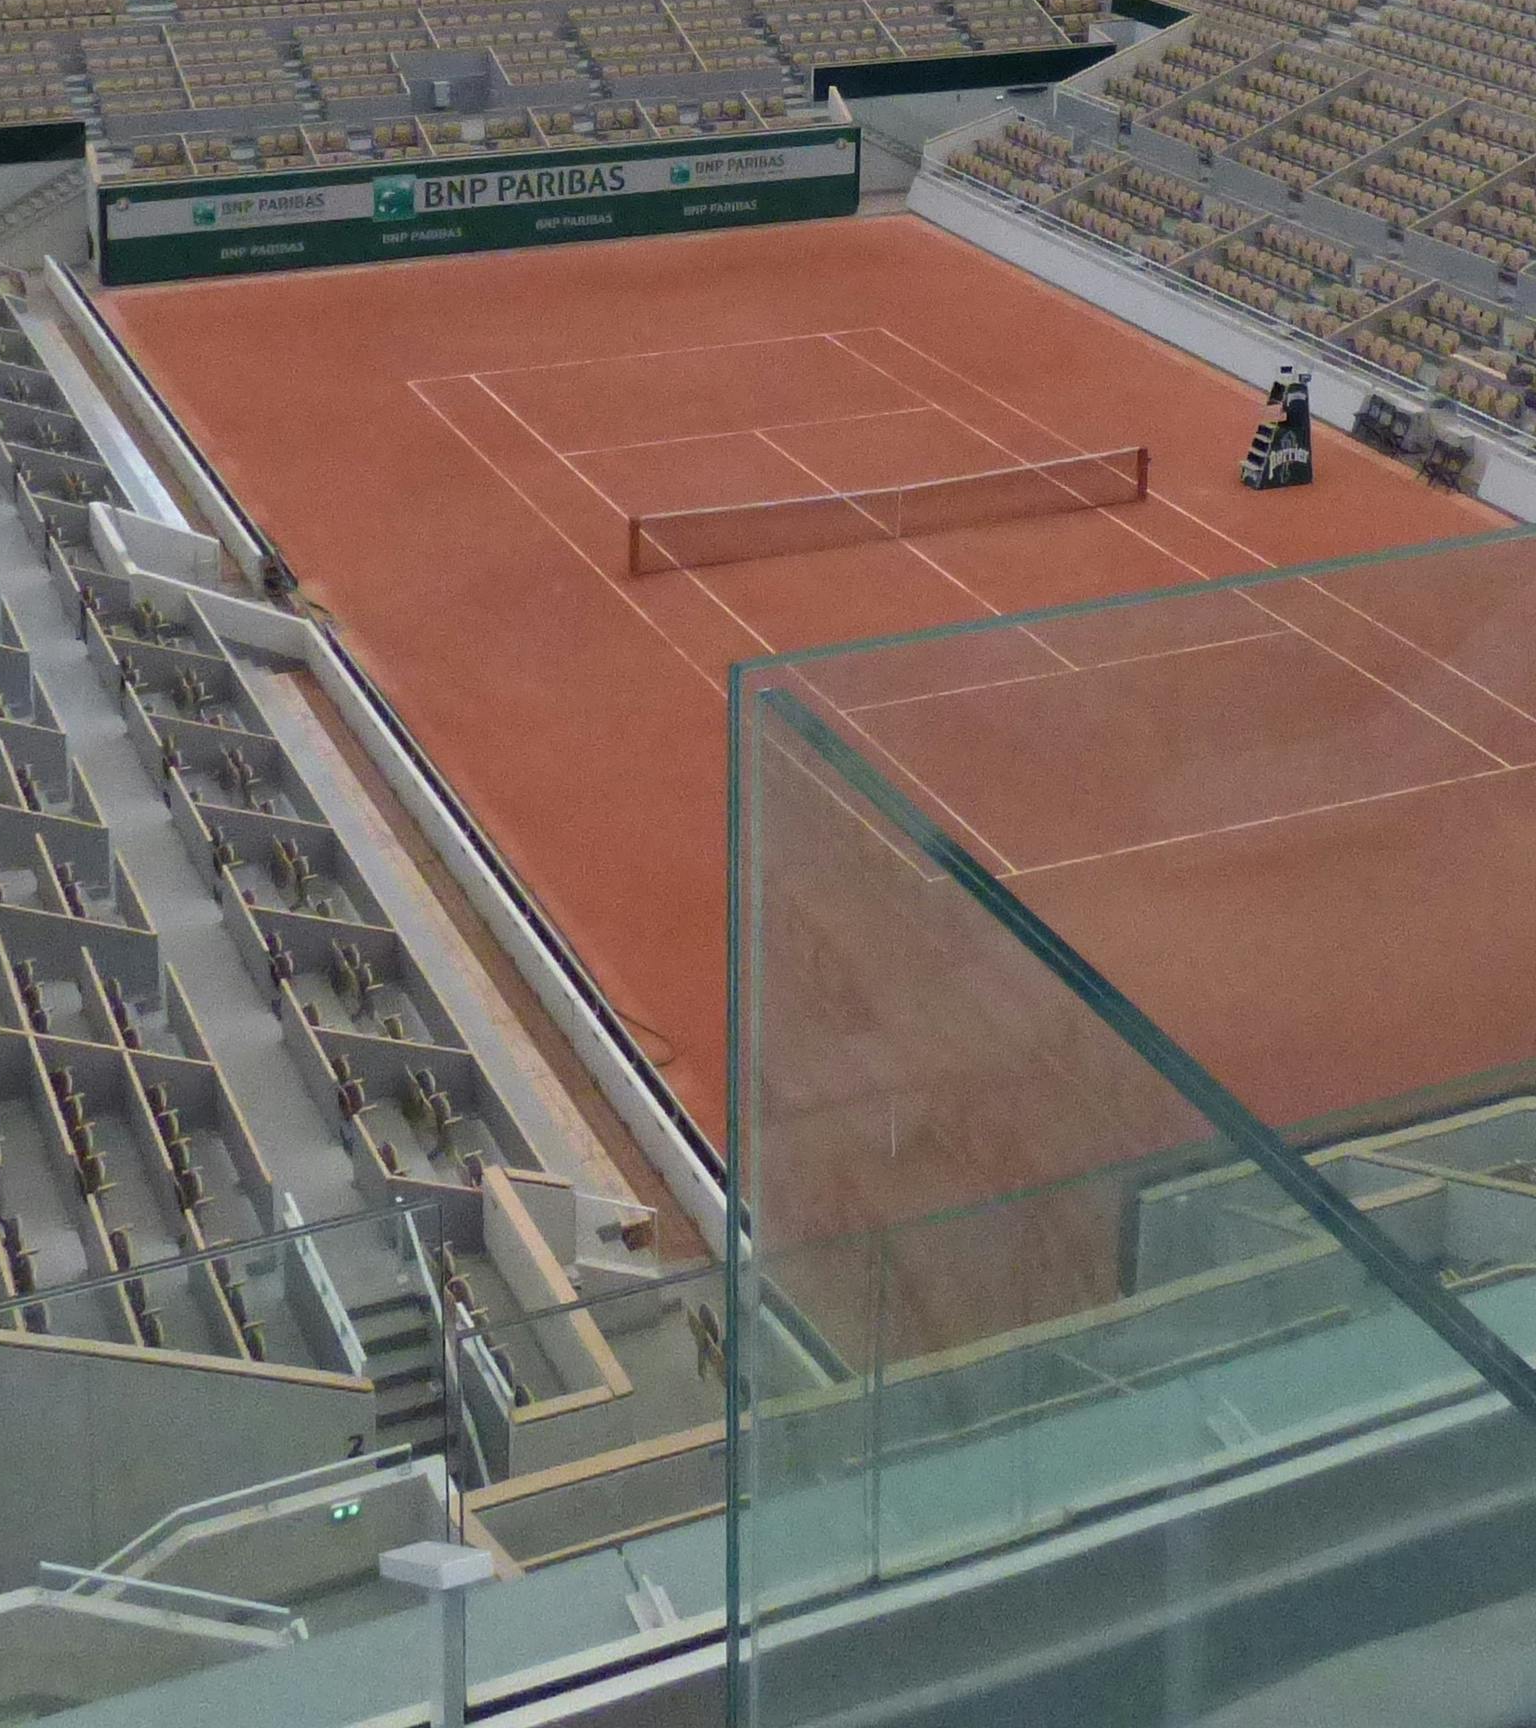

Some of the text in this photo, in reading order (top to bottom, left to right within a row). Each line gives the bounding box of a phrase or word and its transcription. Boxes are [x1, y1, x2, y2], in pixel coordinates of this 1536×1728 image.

[695, 155, 785, 174] BNP PARIBAS
[425, 165, 625, 208] BNP PARIBAS
[221, 199, 254, 216] BNP
[258, 193, 325, 212] PARIBAS
[683, 200, 757, 217] BNP PARIBAS
[536, 213, 613, 230] BNP PARIBAS
[382, 227, 462, 244] BNP PARIBAS
[250, 242, 305, 257] PARIBAS
